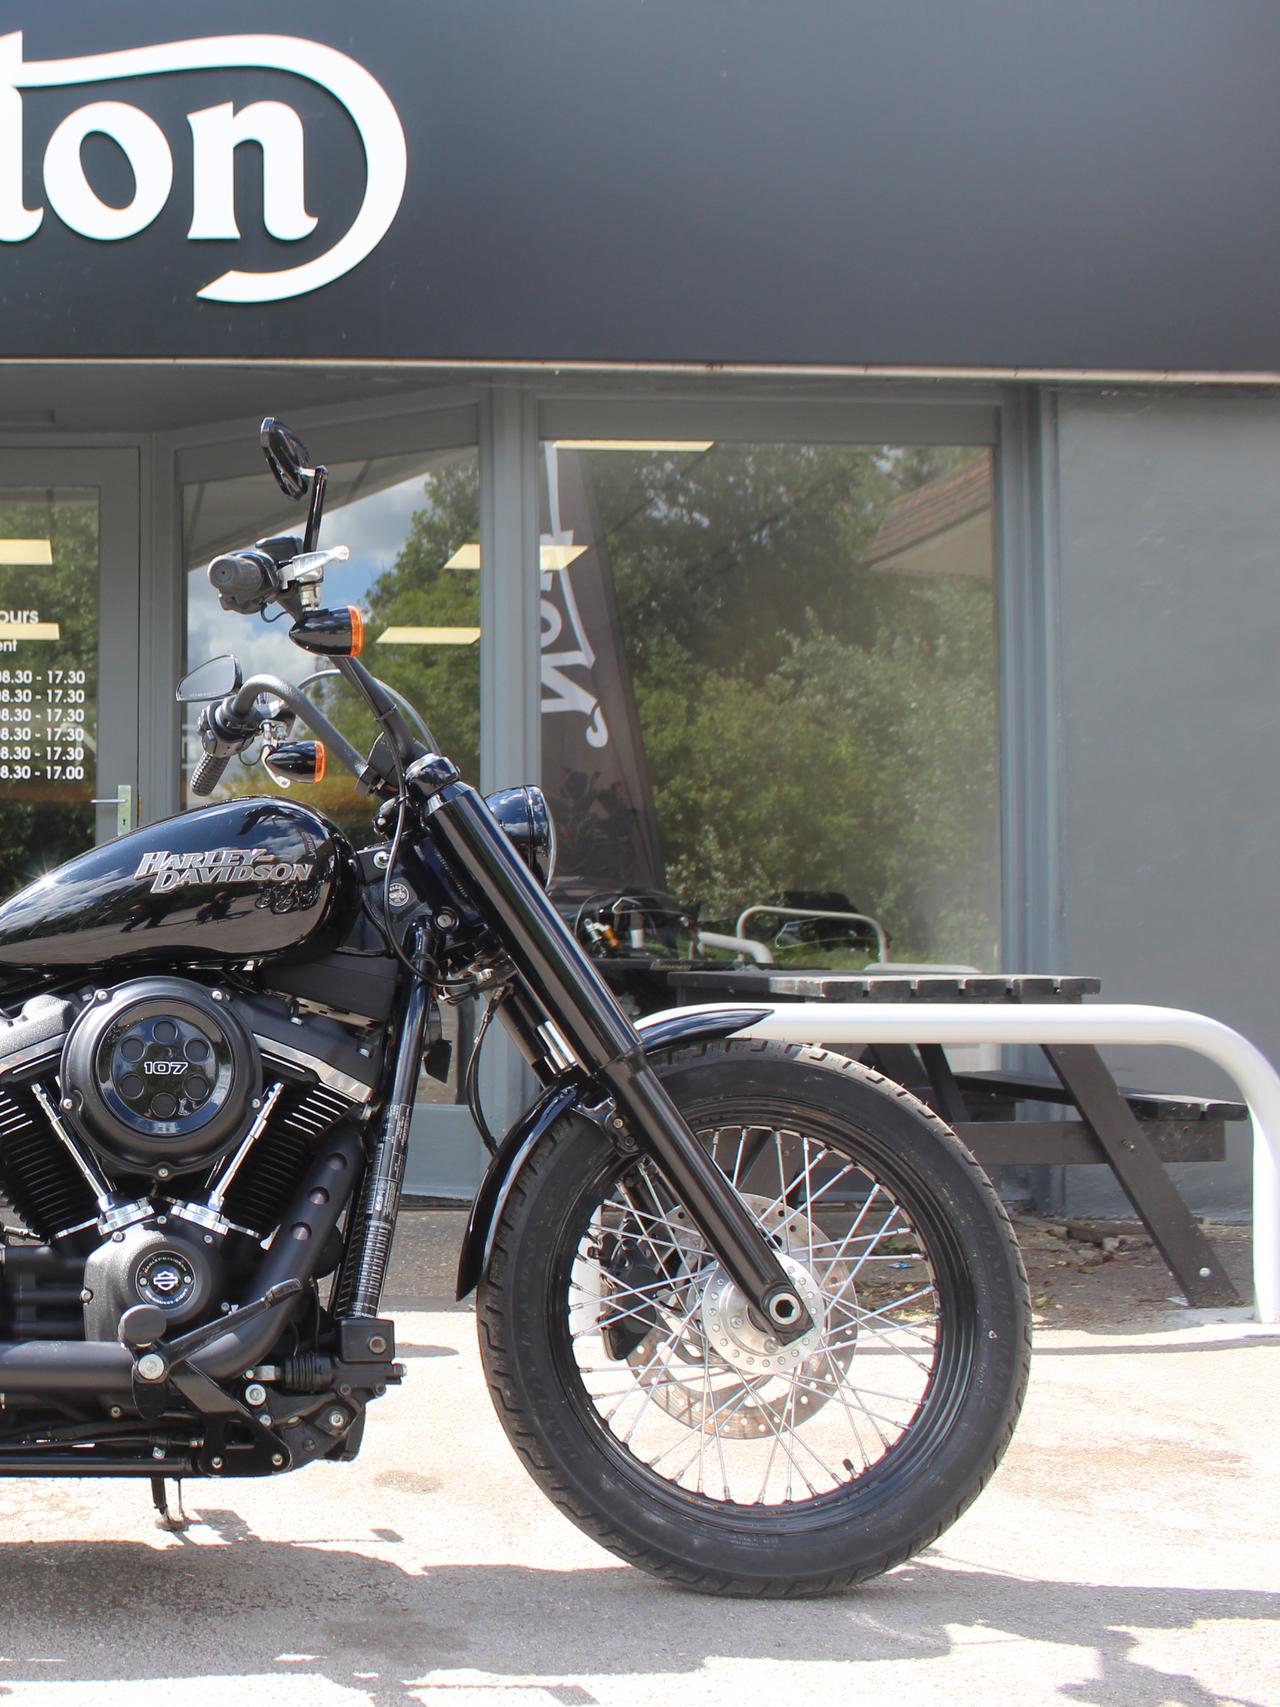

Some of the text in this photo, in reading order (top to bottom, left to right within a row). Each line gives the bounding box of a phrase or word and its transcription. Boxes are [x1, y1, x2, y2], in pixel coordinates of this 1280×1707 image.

[48, 670, 85, 684] 17.30
[47, 689, 85, 703] 17.30
[47, 709, 84, 723] 17.30
[46, 728, 84, 742] 17.30
[46, 747, 84, 761] 17.30
[46, 766, 84, 780] 17.00
[150, 863, 314, 893] DAVIDSON
[144, 1061, 189, 1075] 107
